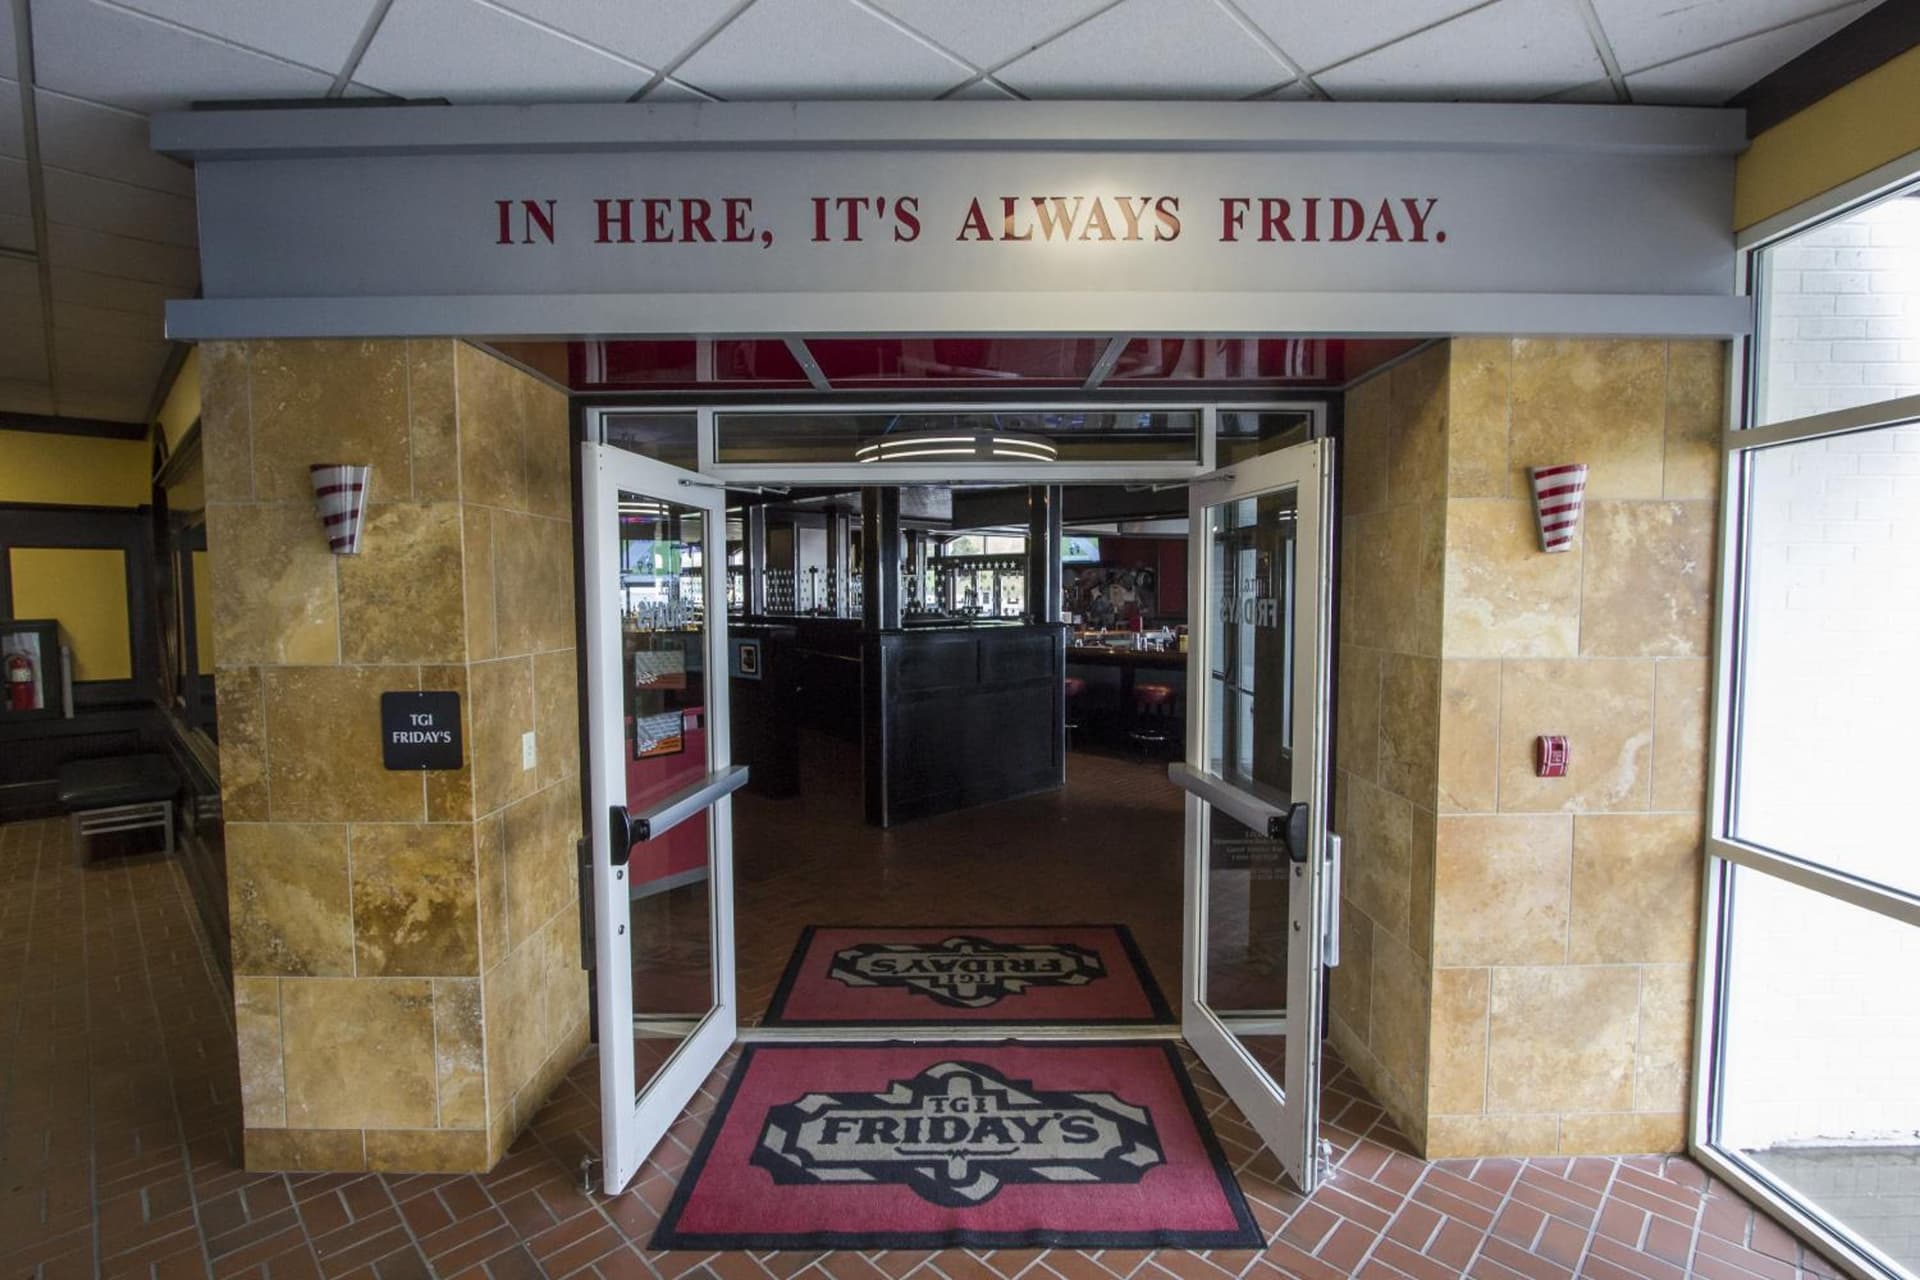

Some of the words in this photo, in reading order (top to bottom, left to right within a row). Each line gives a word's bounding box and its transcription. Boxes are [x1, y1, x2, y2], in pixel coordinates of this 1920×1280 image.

[495, 199, 556, 245] IN
[593, 197, 773, 249] HERE,
[810, 196, 921, 243] IT'S
[955, 195, 1182, 242] ALWAYS
[1219, 197, 1447, 243] FRIDAY.
[409, 714, 433, 726] TGI
[392, 731, 451, 744] FRIDAY'S
[870, 958, 1062, 975] FRIDAY'S
[947, 974, 990, 984] TGI
[928, 1097, 989, 1114] TGI
[817, 1111, 1100, 1146] FRIDAY'S
